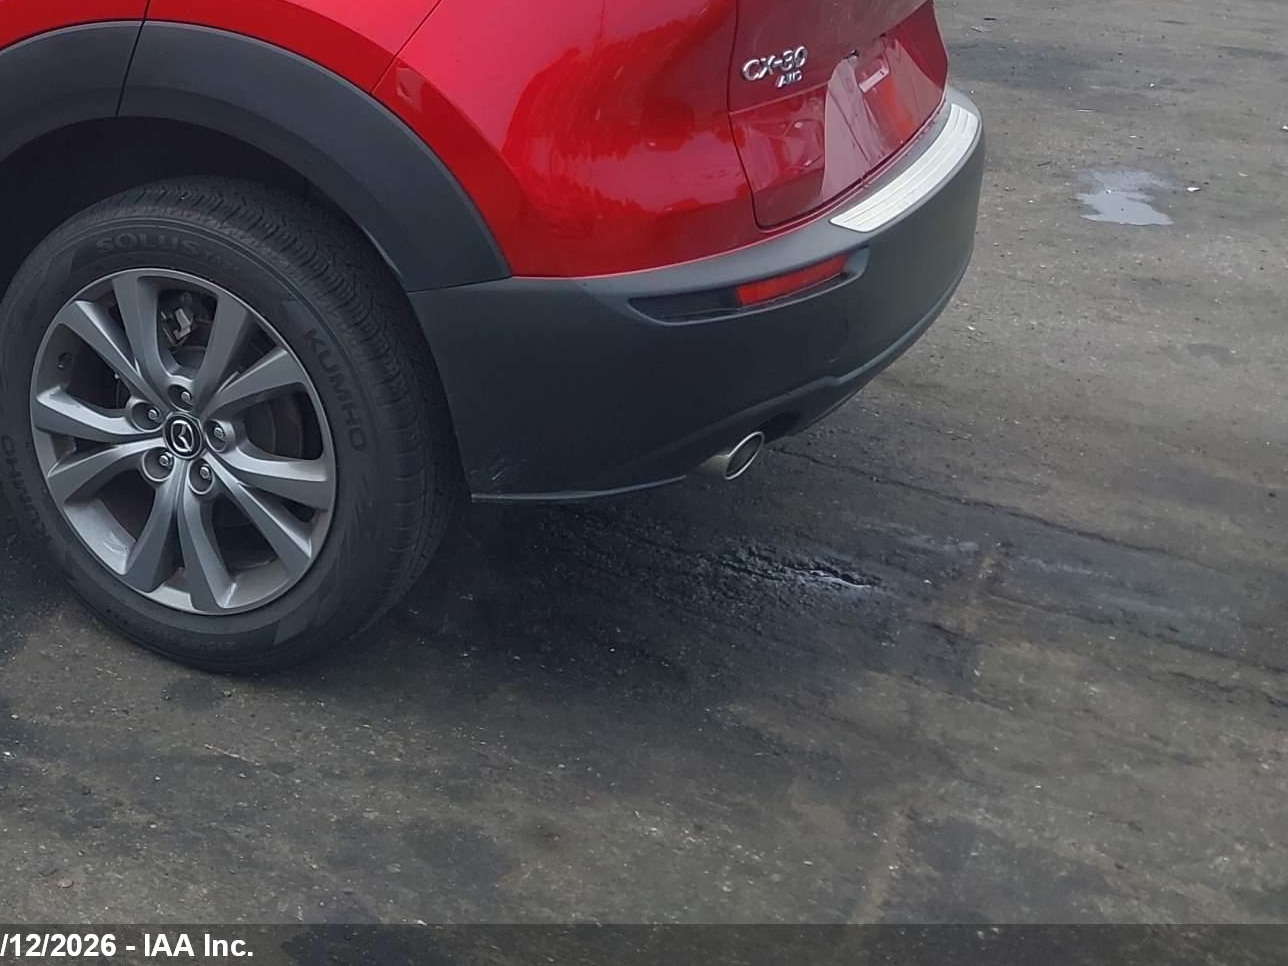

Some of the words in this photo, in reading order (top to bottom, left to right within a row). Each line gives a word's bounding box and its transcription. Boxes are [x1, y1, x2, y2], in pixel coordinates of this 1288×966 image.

[743, 45, 808, 81] CX-30
[776, 70, 802, 88] AWD
[96, 233, 200, 255] SOLUS
[304, 328, 368, 452] KUMHO
